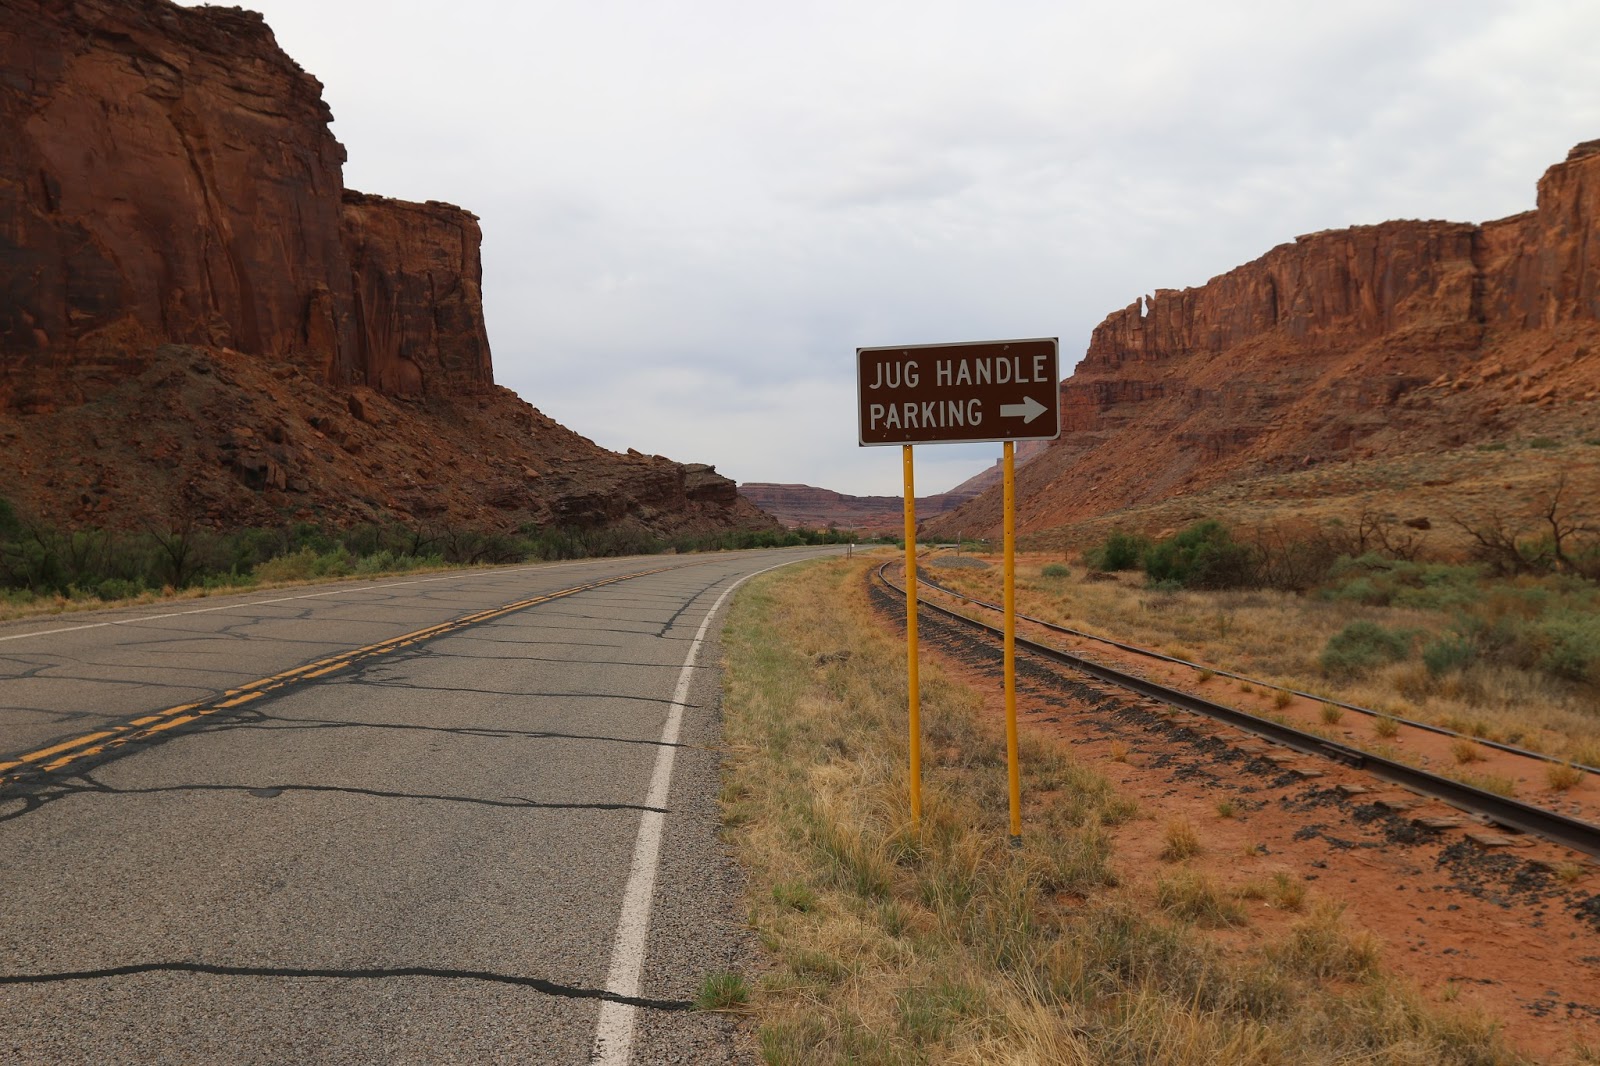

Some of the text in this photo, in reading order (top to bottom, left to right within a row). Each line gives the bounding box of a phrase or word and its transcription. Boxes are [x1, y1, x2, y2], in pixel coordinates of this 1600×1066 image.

[869, 355, 1048, 390] JUG HANDLE
[870, 398, 982, 430] PARKING
